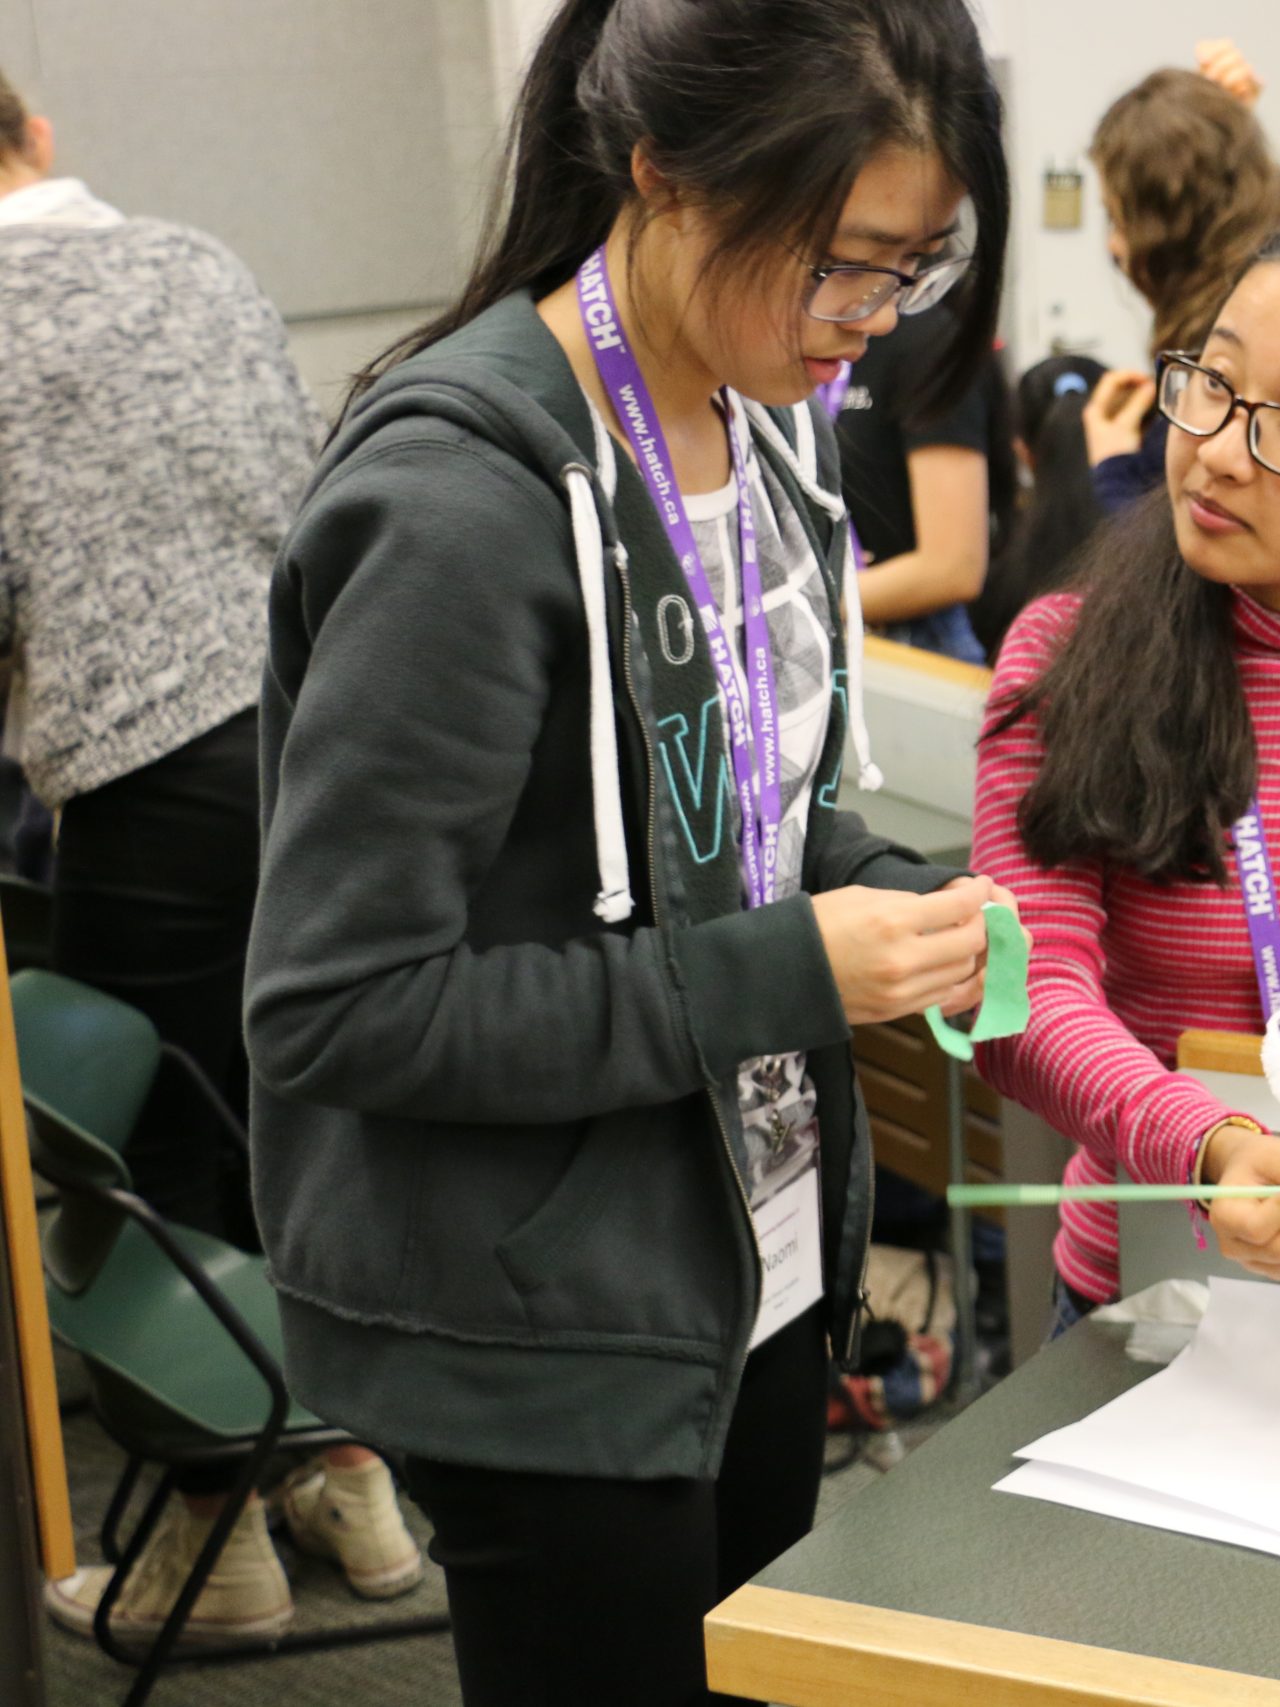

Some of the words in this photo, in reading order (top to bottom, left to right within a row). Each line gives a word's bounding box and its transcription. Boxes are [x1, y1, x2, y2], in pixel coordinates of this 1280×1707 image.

[581, 251, 622, 350] HATCH
[618, 384, 678, 525] www.hatch.ca
[709, 635, 745, 747] HATCH
[755, 647, 775, 787] www.hatch.ca
[764, 823, 778, 904] ATCH
[1235, 815, 1274, 915] HATCH
[760, 1231, 798, 1272] Naomi
